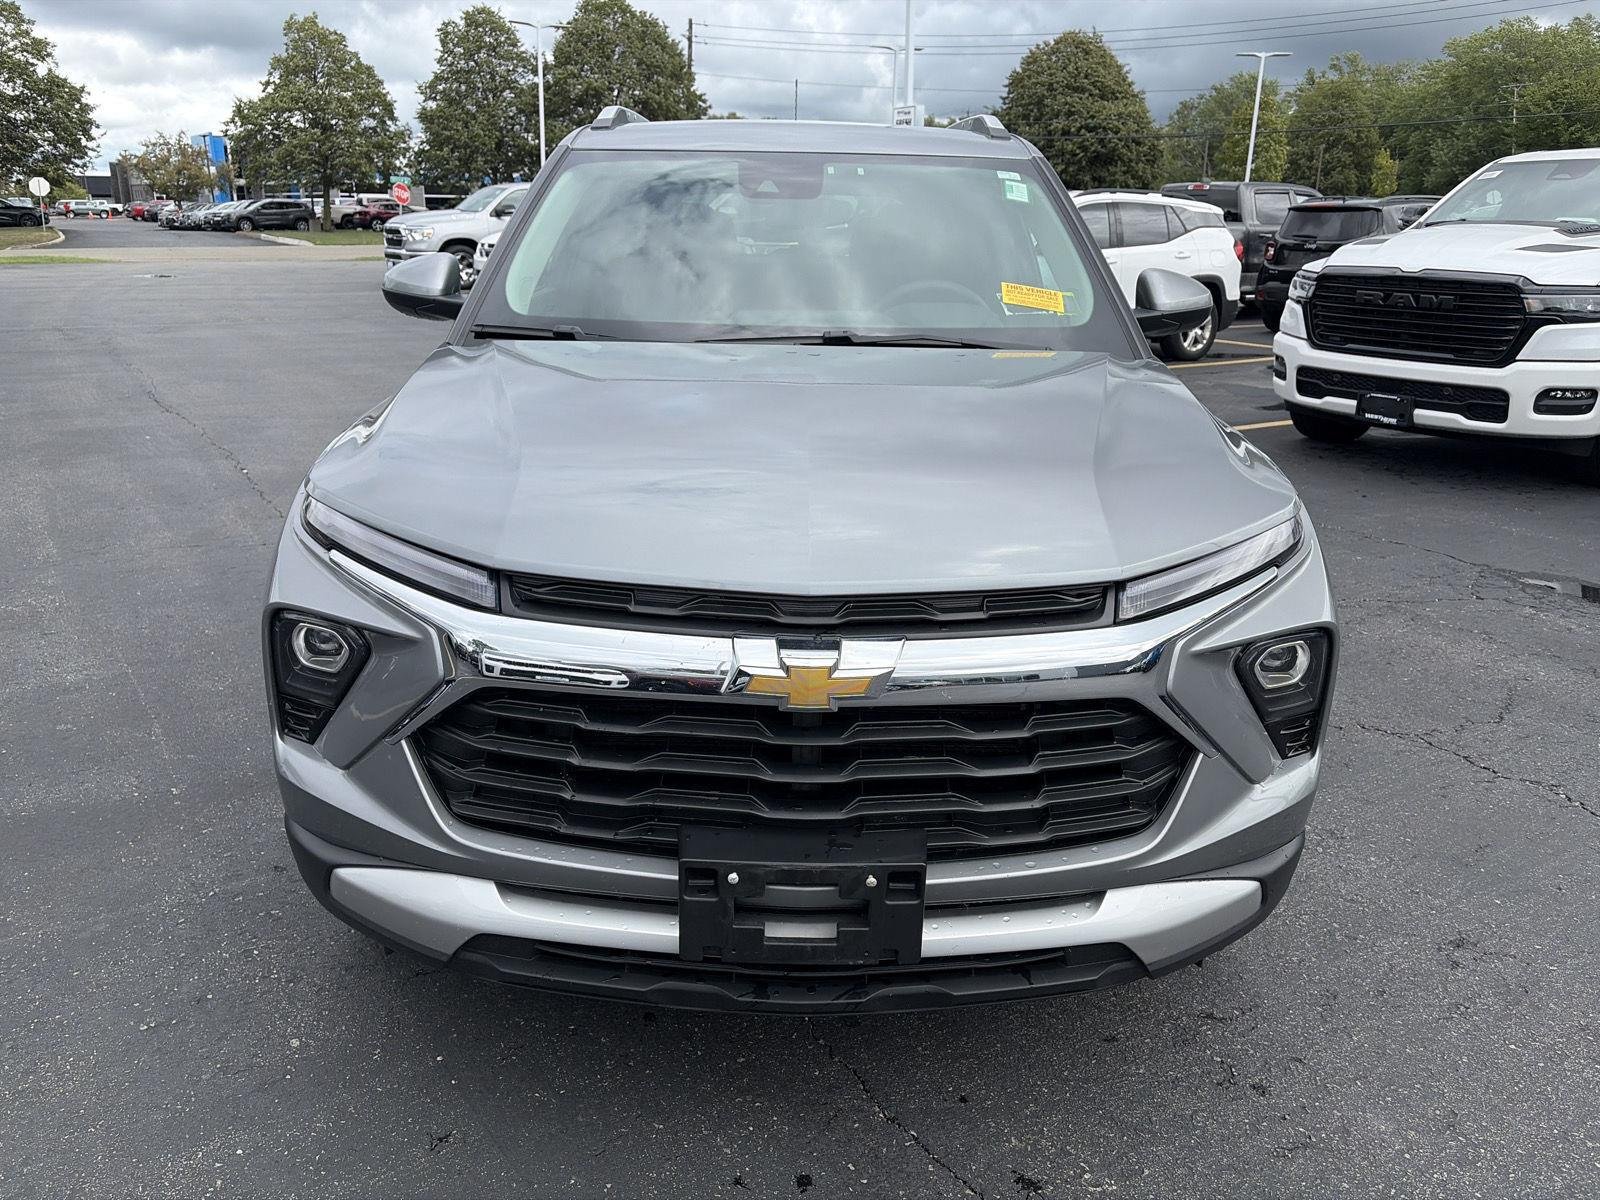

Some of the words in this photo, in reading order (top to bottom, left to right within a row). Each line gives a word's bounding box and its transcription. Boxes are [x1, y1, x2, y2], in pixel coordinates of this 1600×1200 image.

[394, 187, 409, 199] STOP
[1026, 287, 1060, 297] VEHICLE
[1356, 290, 1456, 308] RAM
